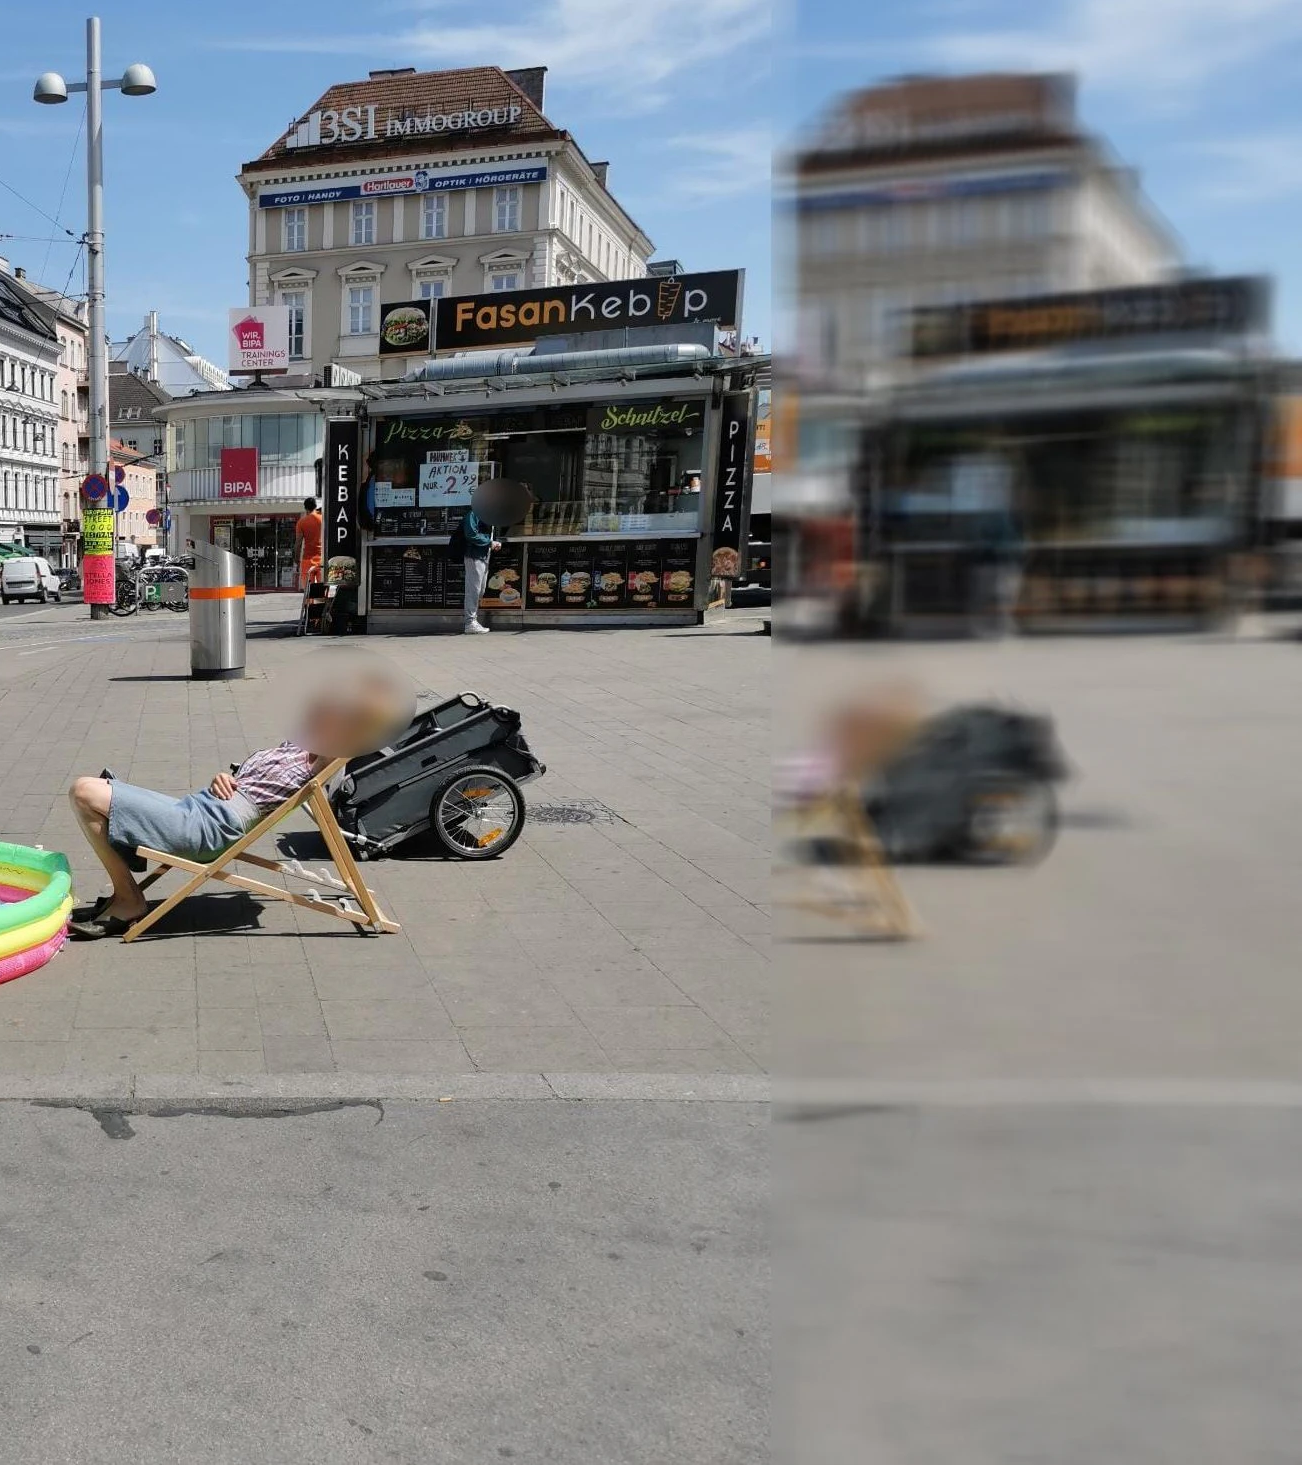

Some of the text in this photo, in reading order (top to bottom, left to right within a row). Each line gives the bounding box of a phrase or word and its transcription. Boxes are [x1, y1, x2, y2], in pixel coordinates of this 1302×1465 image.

[321, 104, 522, 144] 3SI IMMOGROUP
[367, 178, 413, 192] Hartlauer
[434, 170, 539, 189] OPTIK HÖRGERÄTE
[274, 190, 342, 204] FOTO HANDY
[242, 340, 262, 348] BIPA
[241, 350, 286, 359] TRAININGS
[241, 359, 274, 367] CENTER
[601, 403, 700, 430] Schnitzel
[383, 419, 448, 444] Pizza
[428, 464, 468, 479] AKTION
[721, 420, 740, 532] PIZZA
[224, 482, 254, 494] BIPA
[336, 443, 350, 544] KEBAP
